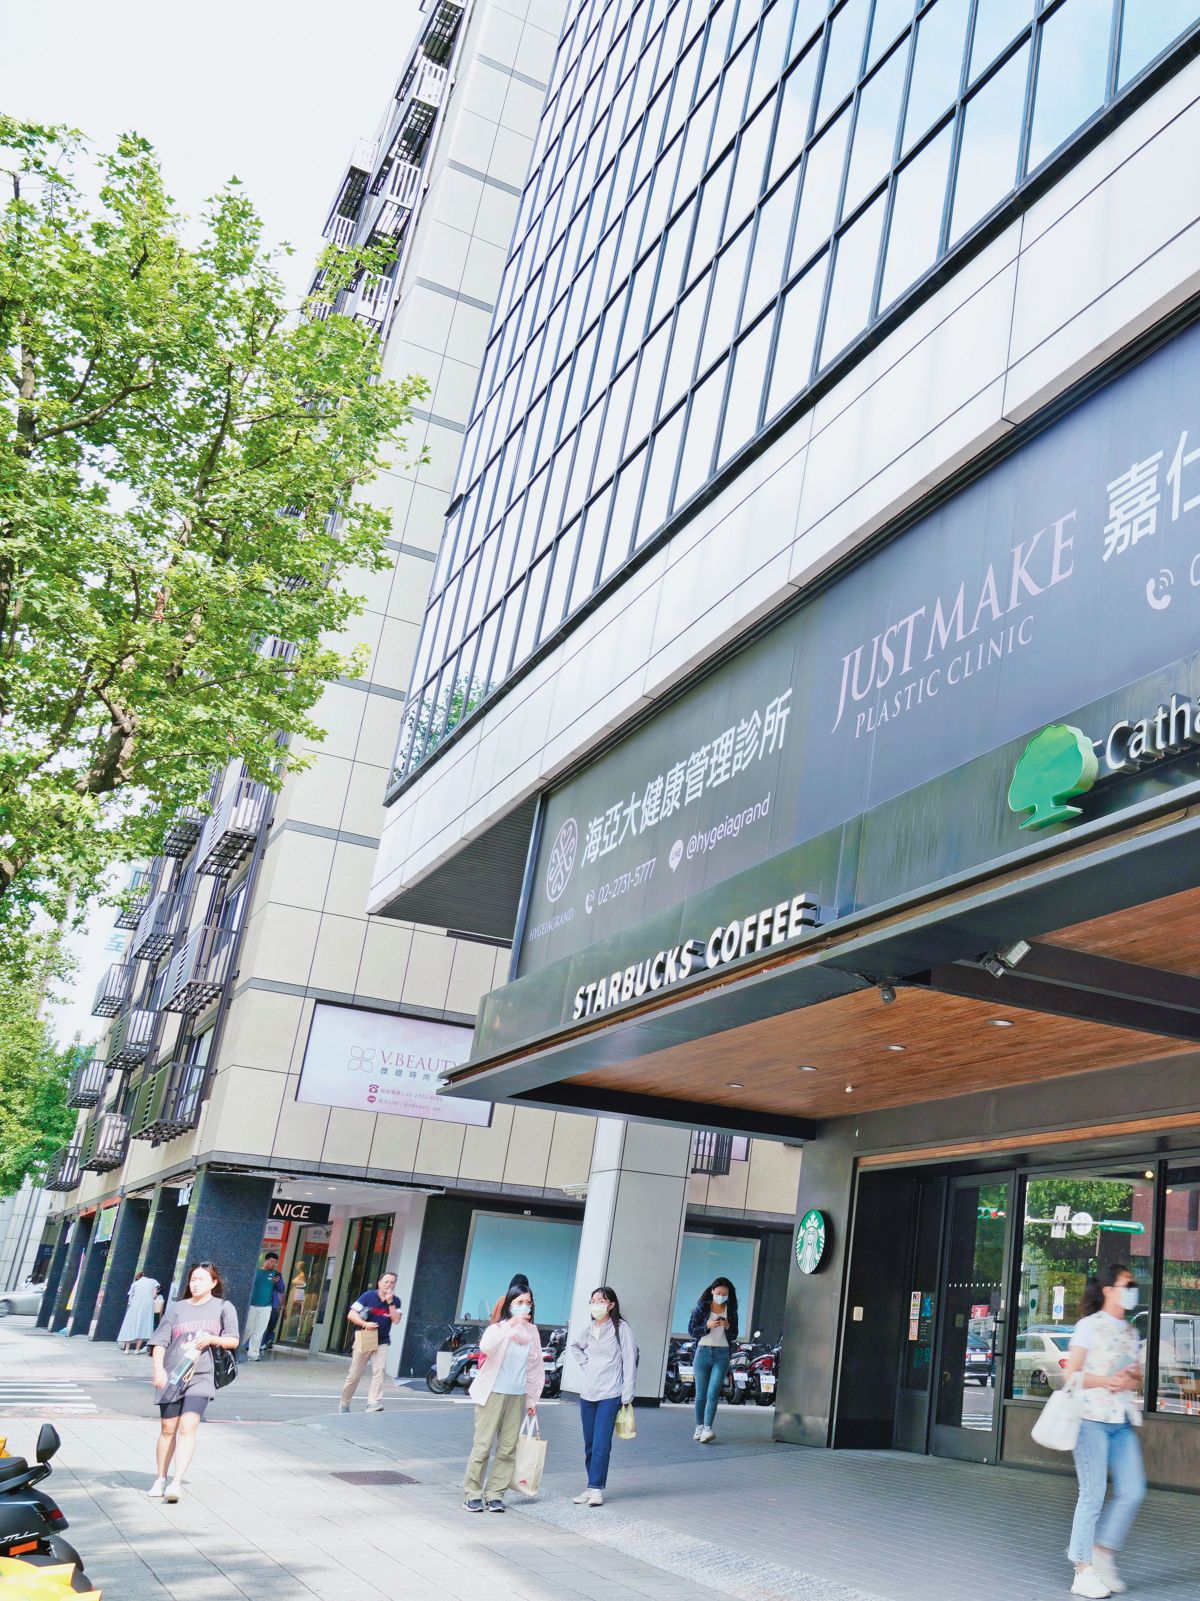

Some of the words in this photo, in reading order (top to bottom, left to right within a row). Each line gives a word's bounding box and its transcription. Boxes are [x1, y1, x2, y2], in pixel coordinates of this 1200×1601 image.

[855, 669, 940, 739] PLASTIC
[947, 615, 1034, 685] CLINIC
[581, 688, 792, 869] 海亞大健康管理診所
[686, 791, 771, 860] @hygeiagrand
[597, 857, 657, 906] 02-2731-5777
[528, 907, 575, 942] HYGEIAGRAND
[572, 939, 697, 1020] STARBUCKS
[703, 893, 806, 970] COFFEE
[273, 1203, 311, 1219] NICE
